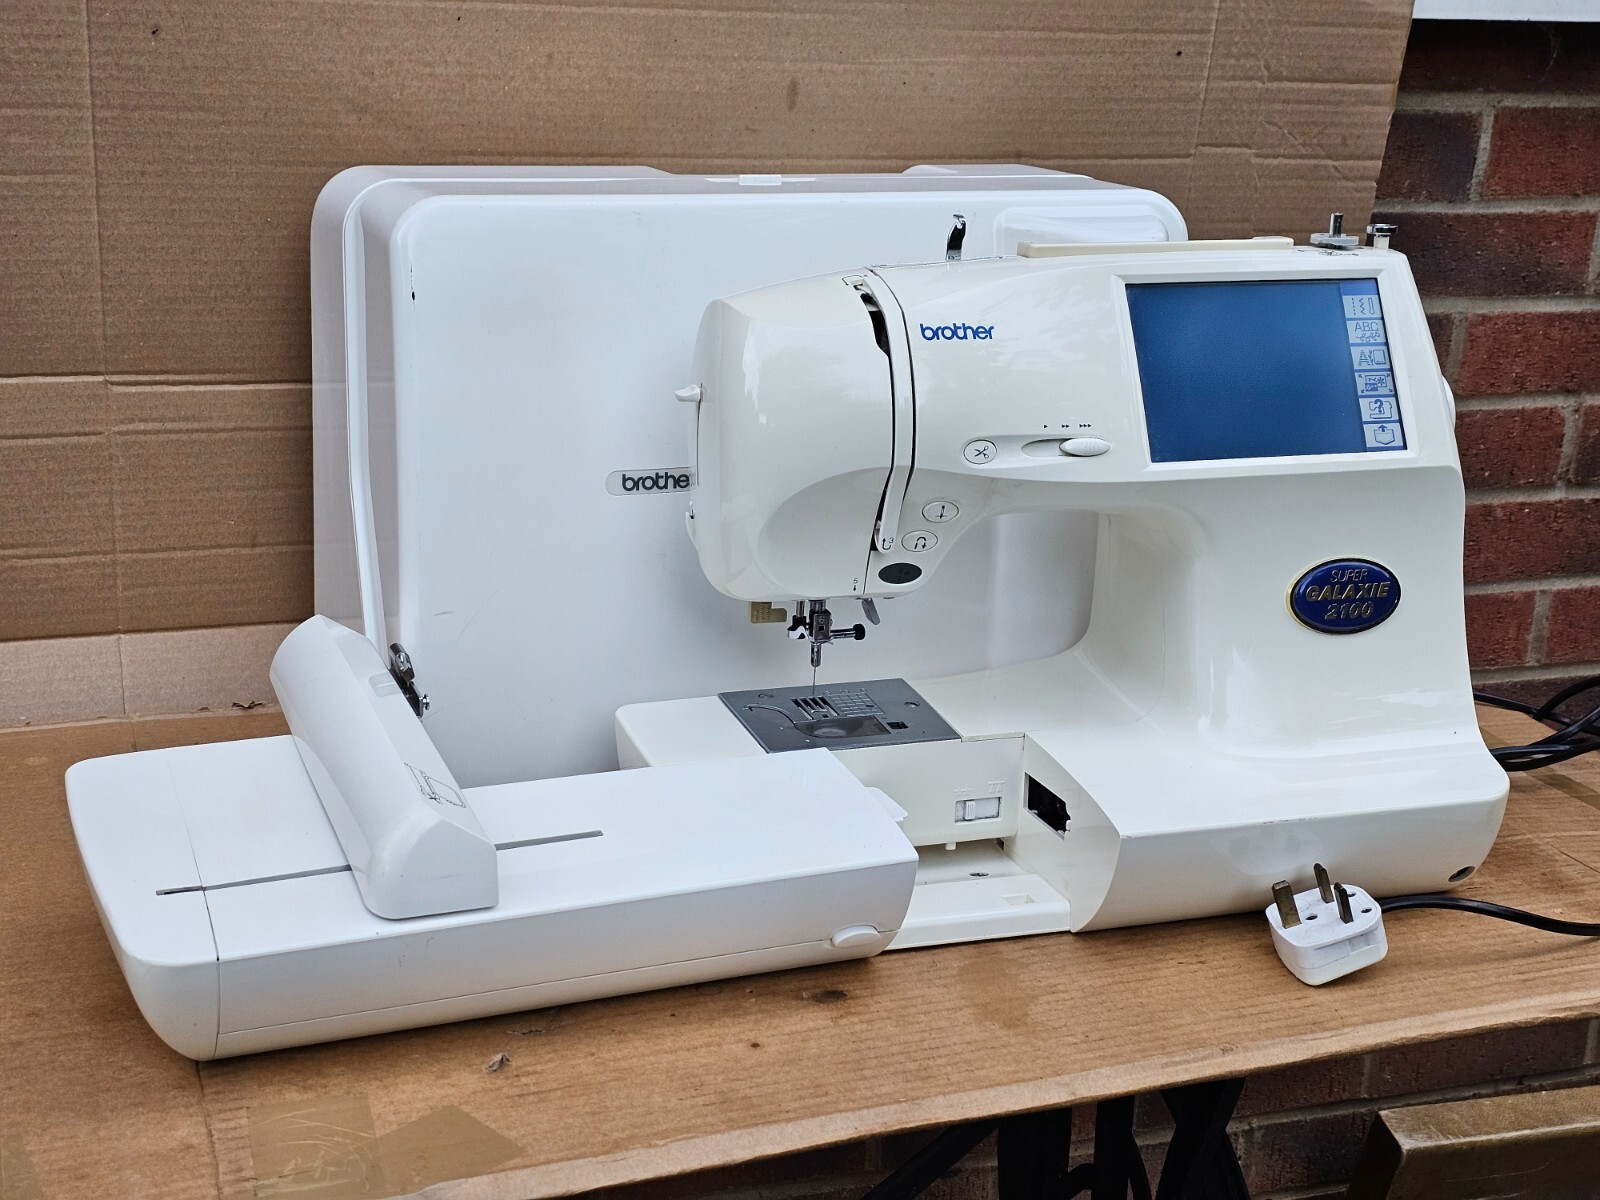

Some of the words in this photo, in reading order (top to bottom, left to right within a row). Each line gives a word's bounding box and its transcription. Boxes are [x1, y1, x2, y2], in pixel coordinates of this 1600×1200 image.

[919, 322, 995, 341] brother
[1354, 321, 1379, 332] ABC
[621, 471, 690, 492] brothe
[1331, 569, 1368, 582] SUPER
[1306, 582, 1390, 602] GALAXIE
[1325, 601, 1373, 619] 2100
